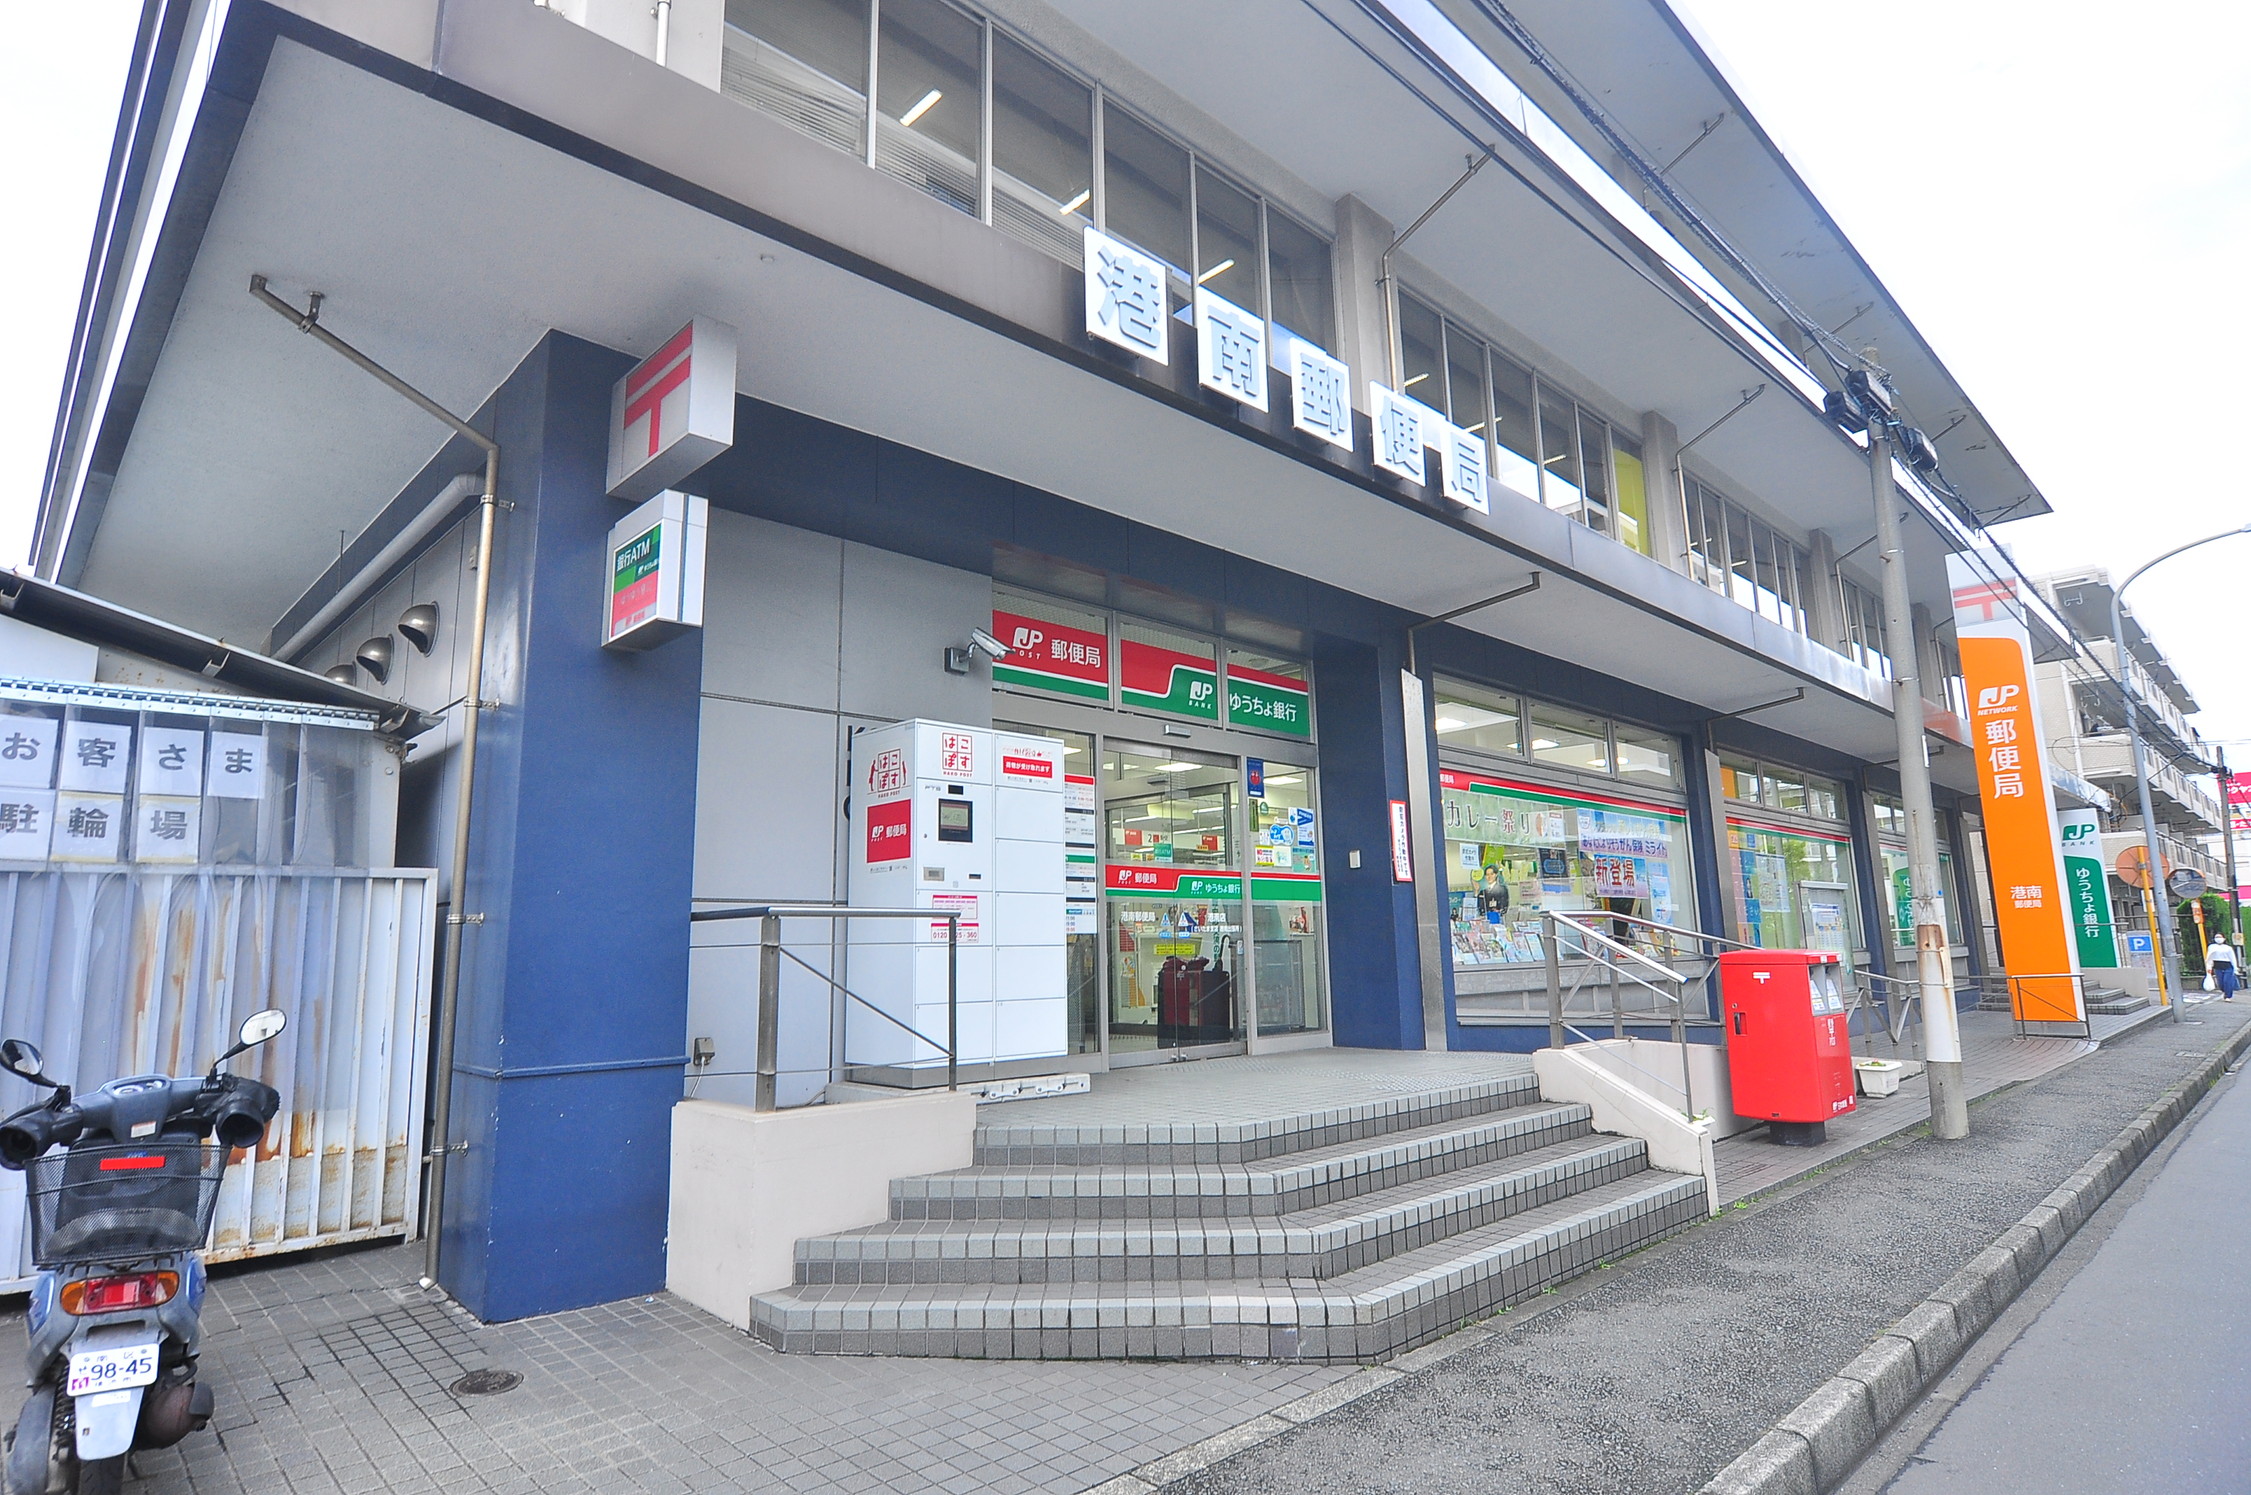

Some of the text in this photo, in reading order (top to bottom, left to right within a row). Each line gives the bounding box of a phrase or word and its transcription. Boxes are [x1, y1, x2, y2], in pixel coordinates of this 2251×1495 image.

[1097, 245, 1485, 502] 港南郵便局
[617, 538, 650, 572] 銀行ATM
[1051, 638, 1101, 668] 郵便局
[1188, 699, 1212, 710] BANK
[1229, 692, 1297, 722] ゆうちょ銀行
[1978, 705, 2018, 716] NETWORK
[945, 736, 969, 750] はこ
[2, 732, 254, 775] お客さま
[945, 752, 970, 768] ぽす
[1985, 719, 2024, 799] 郵便局
[0, 803, 188, 840] 駐輪場
[1447, 801, 1529, 834] カレー祭り
[886, 823, 907, 838] 郵便局
[1135, 872, 1157, 884] 郵便局
[1596, 858, 1635, 887] 新登場
[1205, 883, 1240, 895] ゆうちょ銀行
[2010, 885, 2042, 899] 港南
[2014, 899, 2042, 908] 郵便局
[2076, 867, 2100, 938] ゆうちょ銀行
[1121, 911, 1156, 922] 港南郵便局
[2133, 939, 2145, 950] P
[91, 1357, 152, 1381] 98-45
